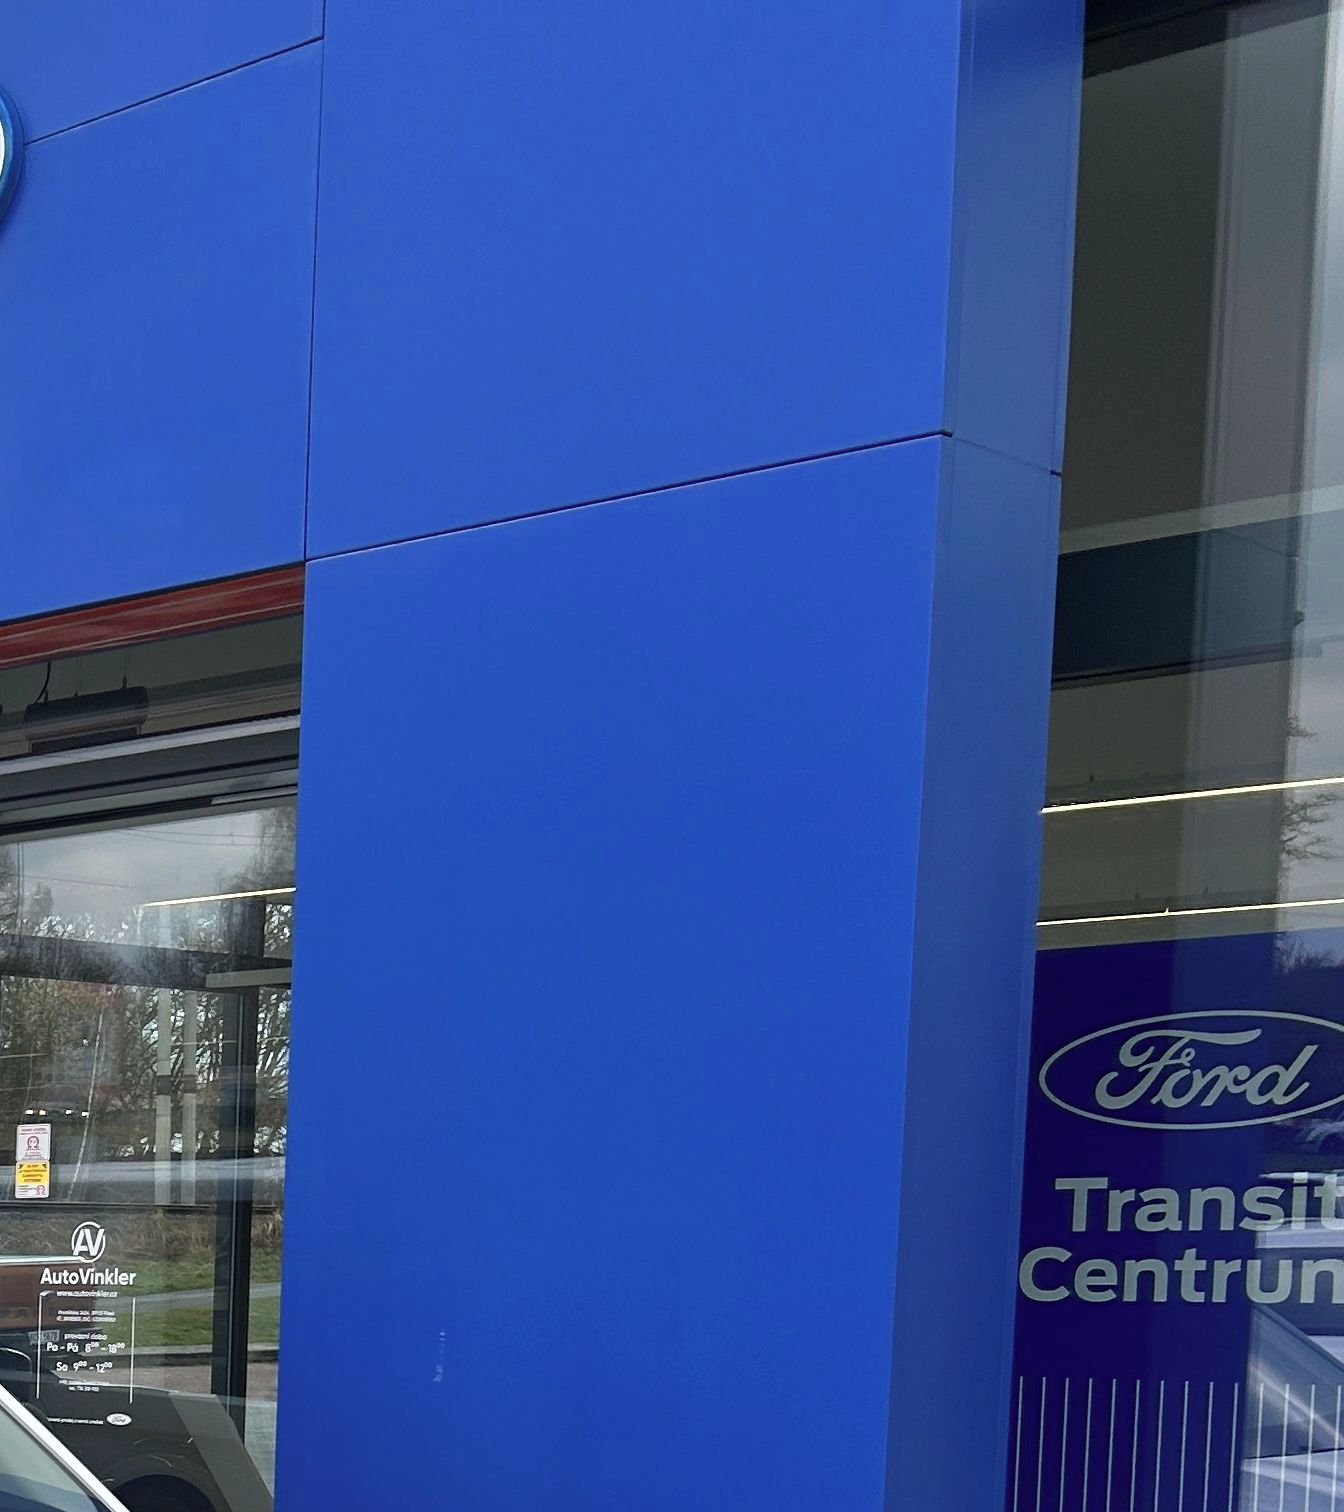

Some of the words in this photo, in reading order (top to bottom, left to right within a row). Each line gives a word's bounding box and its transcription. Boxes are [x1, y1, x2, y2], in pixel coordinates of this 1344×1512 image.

[1094, 1029, 1318, 1110] Ford
[40, 1267, 137, 1286] AutoVinkler
[46, 1342, 59, 1352] Po
[56, 1361, 69, 1372] So
